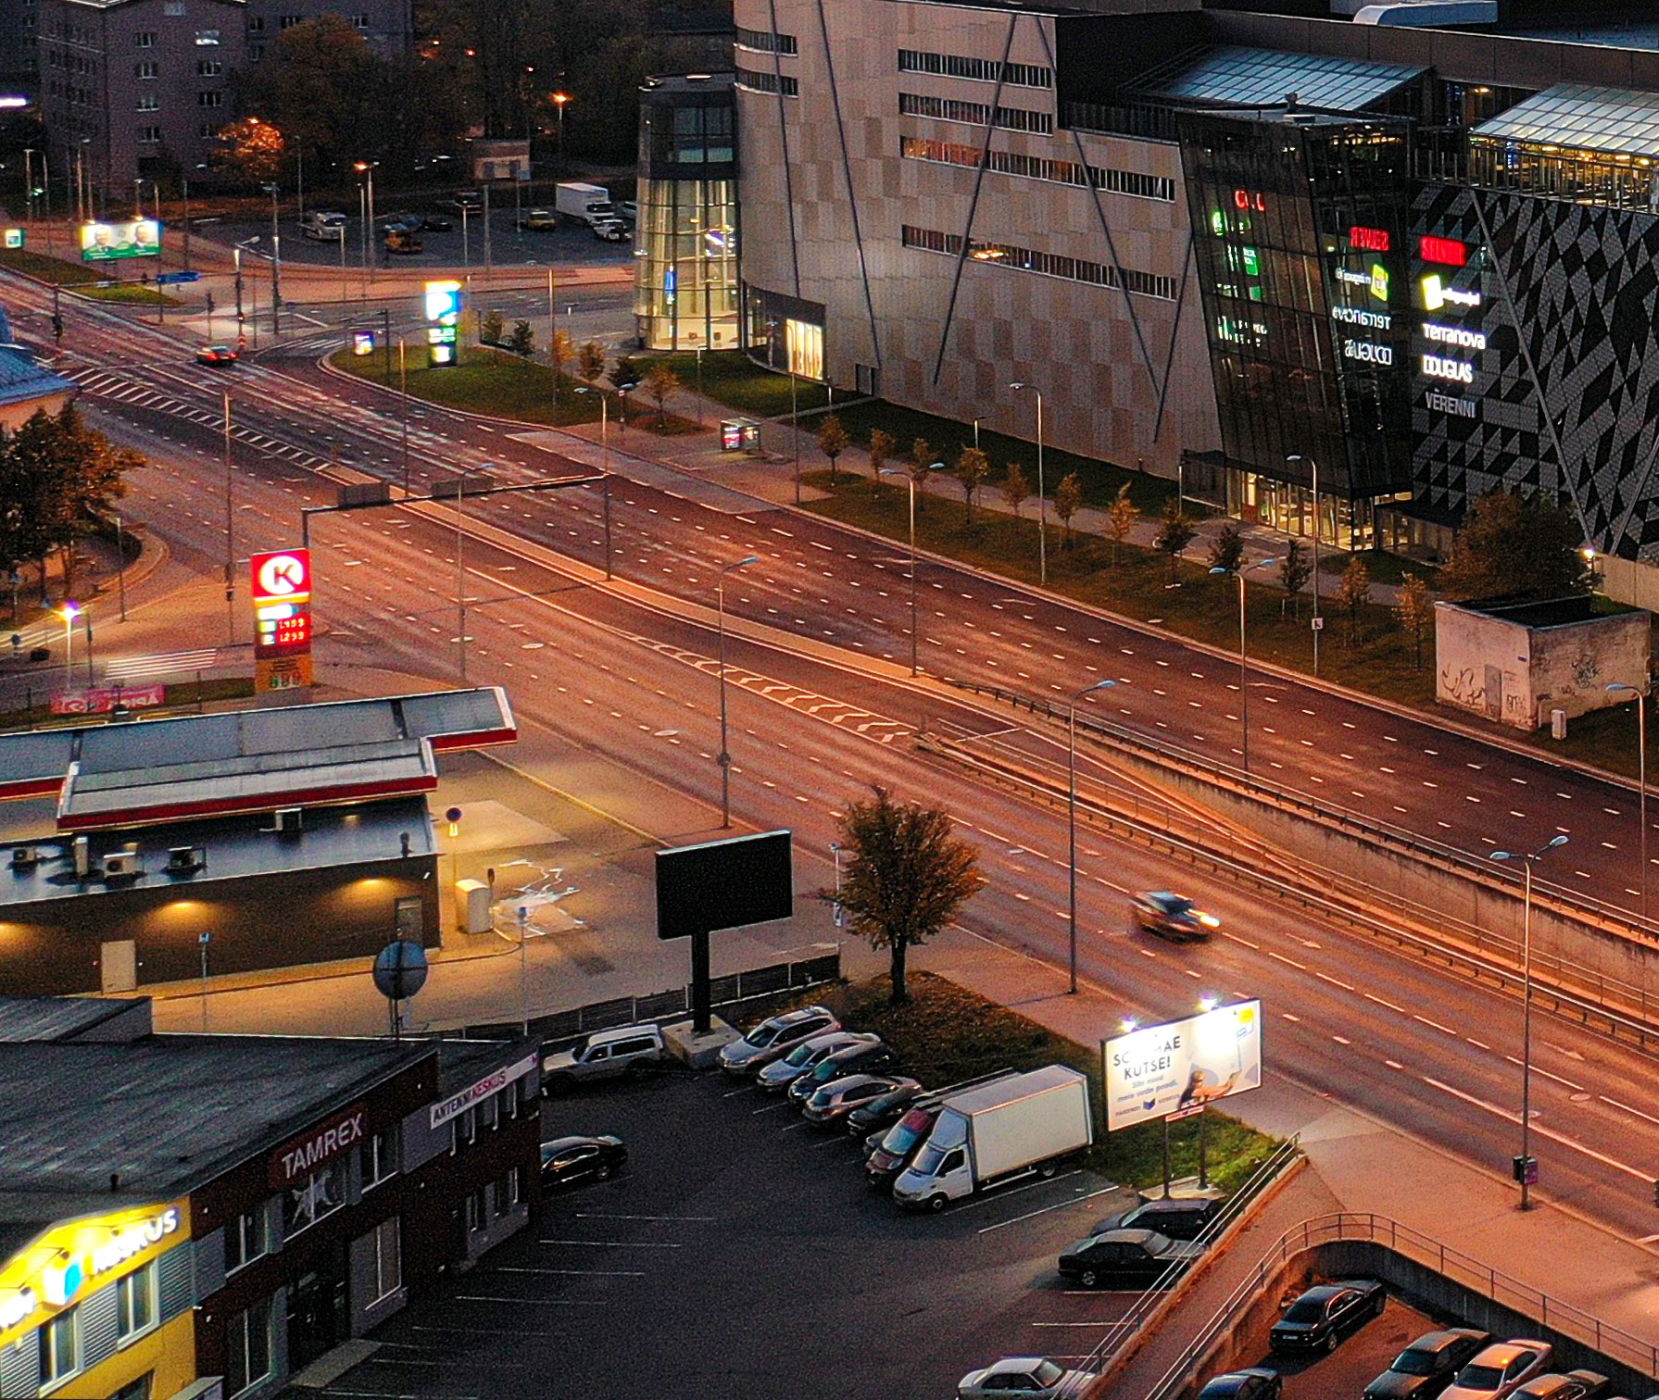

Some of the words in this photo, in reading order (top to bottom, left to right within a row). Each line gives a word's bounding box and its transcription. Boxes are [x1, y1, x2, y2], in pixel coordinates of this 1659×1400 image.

[1423, 355, 1472, 383] DOUGLAS
[1124, 1055, 1171, 1080] KUTSE!
[281, 1112, 363, 1180] TAMREX
